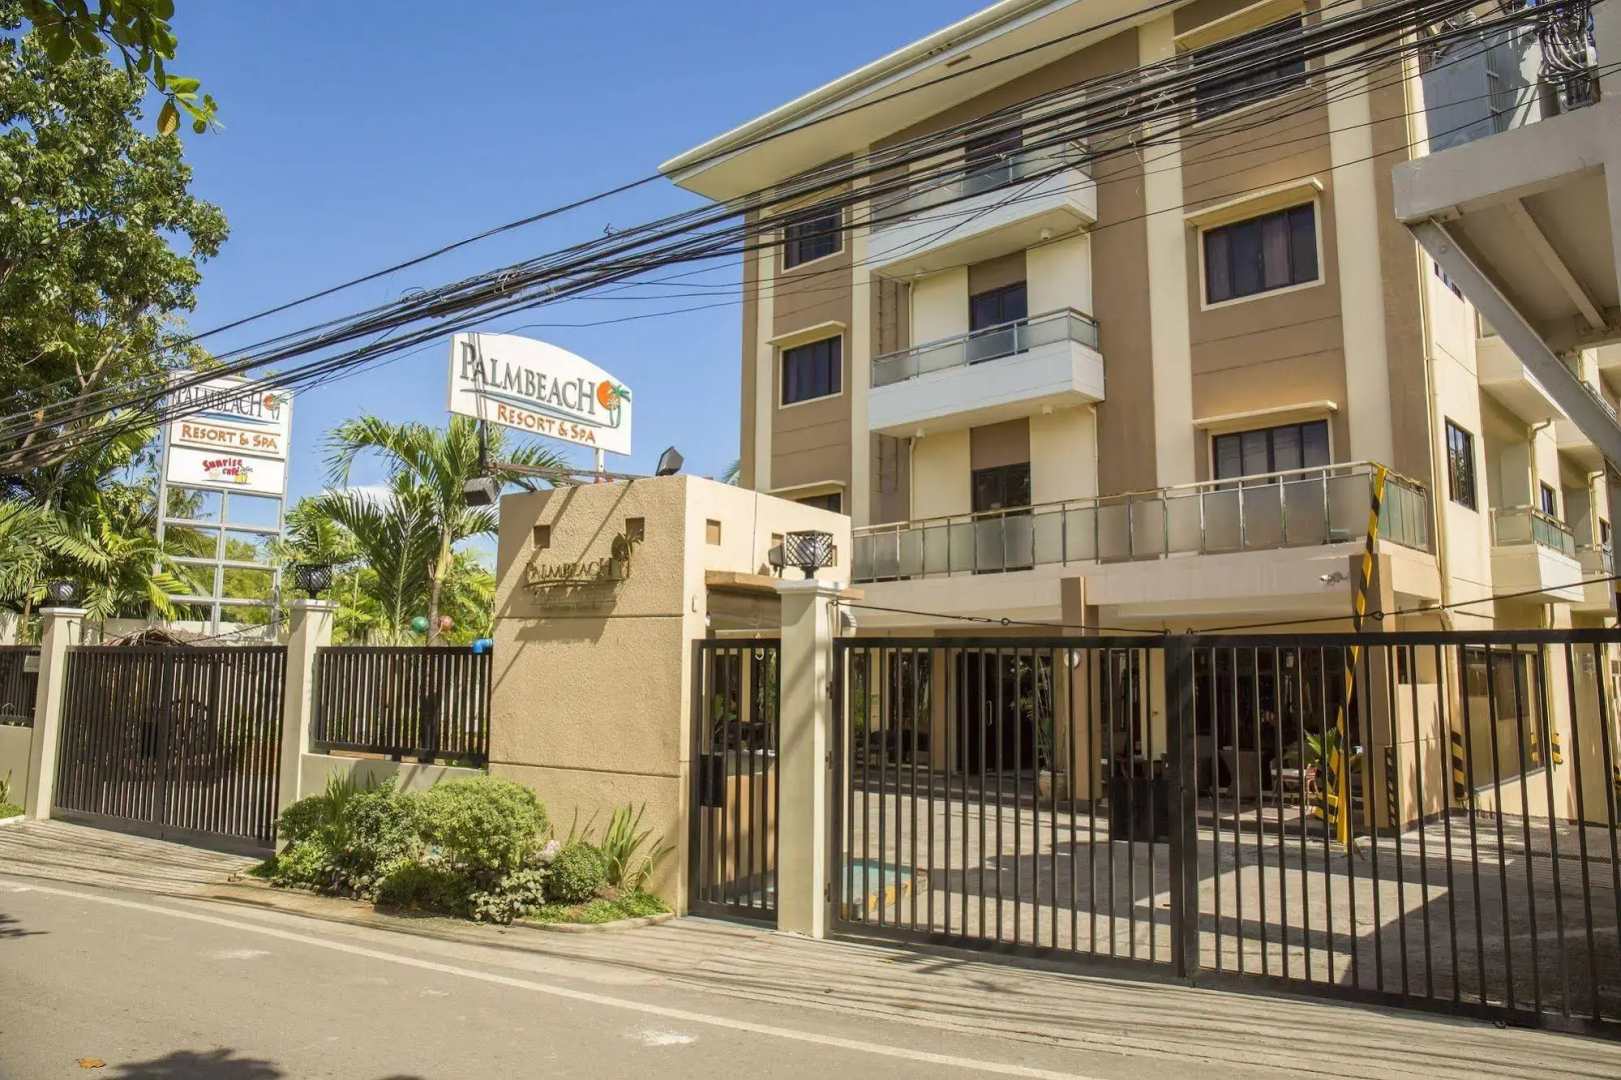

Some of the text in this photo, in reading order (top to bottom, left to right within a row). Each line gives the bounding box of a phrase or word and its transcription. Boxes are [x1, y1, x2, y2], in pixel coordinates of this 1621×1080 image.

[459, 341, 596, 415] PALMBEACH
[181, 424, 278, 449] RESORT & SPA
[497, 403, 596, 444] RESORT & SPA
[202, 457, 243, 472] Sunrise
